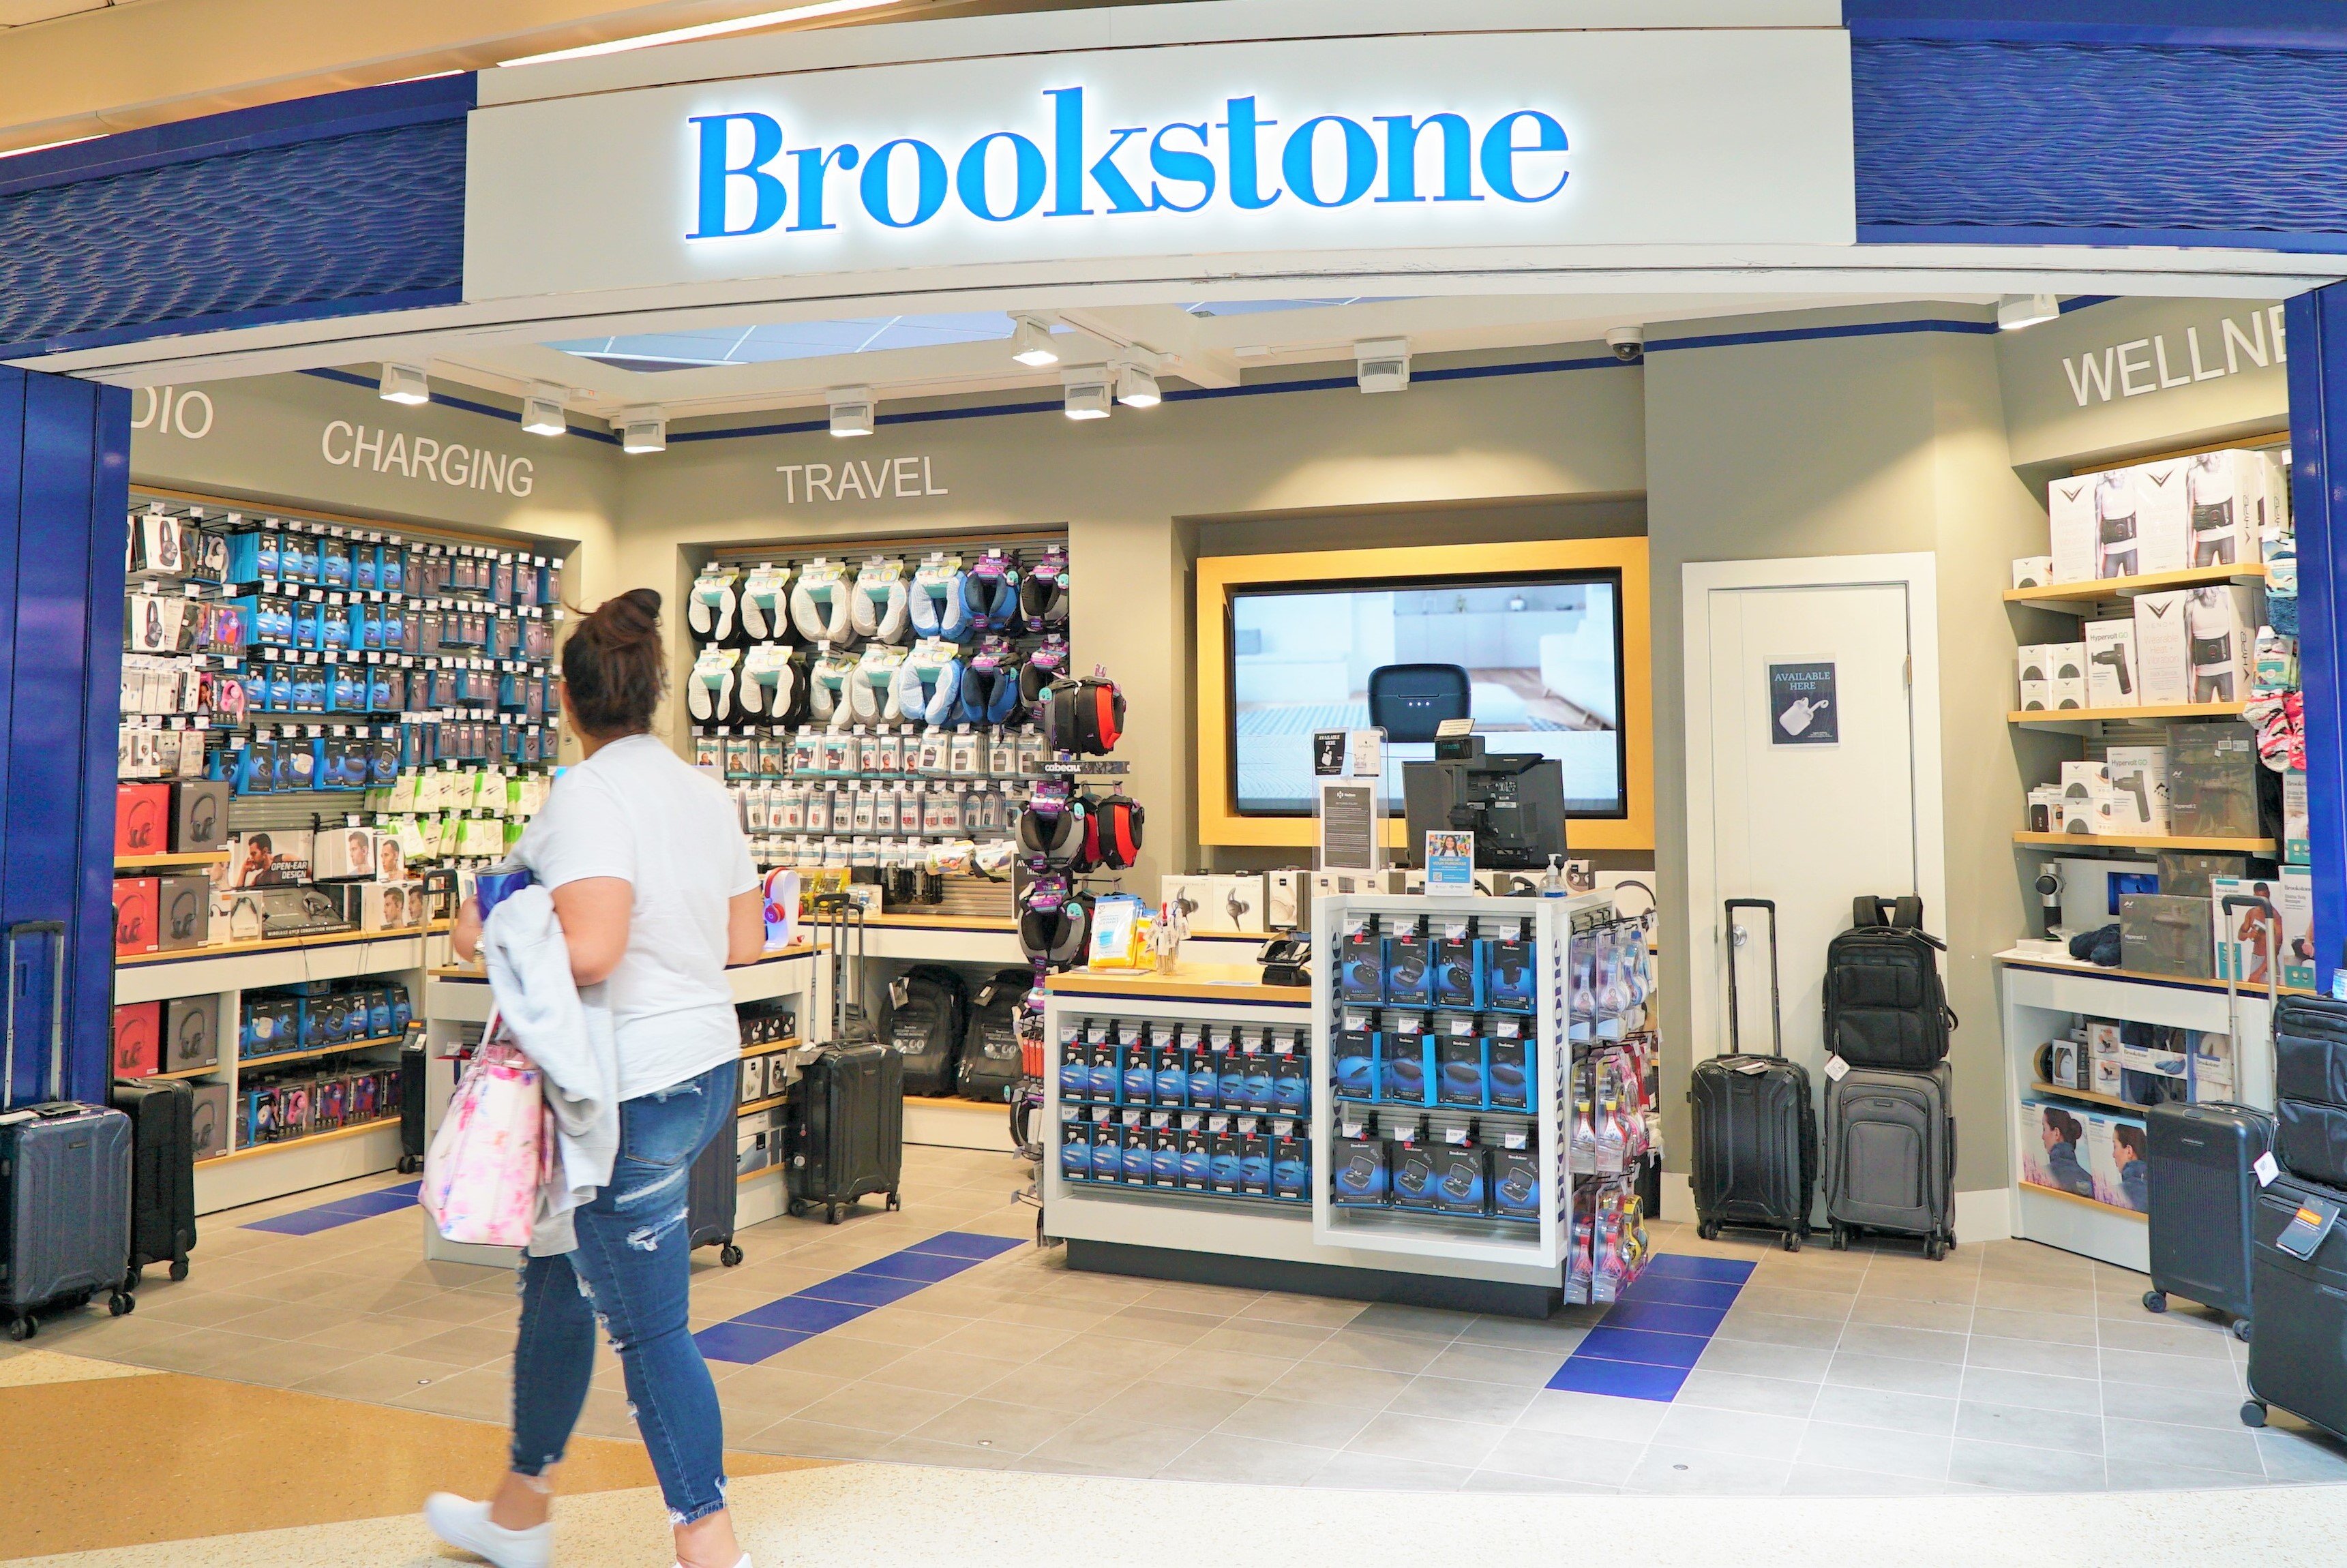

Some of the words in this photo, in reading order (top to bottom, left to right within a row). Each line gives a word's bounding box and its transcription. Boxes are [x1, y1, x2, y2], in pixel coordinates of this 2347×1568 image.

[685, 86, 1570, 240] Brookstone
[321, 419, 535, 498] CHARGING
[775, 455, 949, 503] TRAVEL
[2146, 621, 2176, 629] VENOM
[2090, 633, 2117, 642] Hypervolt
[2144, 633, 2179, 644] Wearable
[2150, 645, 2168, 654] Heat
[2146, 655, 2179, 665] Vibration
[1774, 671, 1831, 682] AVAILABLE
[1790, 681, 1816, 691] HERE
[1044, 763, 1081, 772] cabeau
[2111, 759, 2137, 767] Hypervolt
[271, 862, 308, 871] OPEN-EAR
[281, 871, 307, 879] DESIGN
[1553, 937, 1566, 1224] Brookstone
